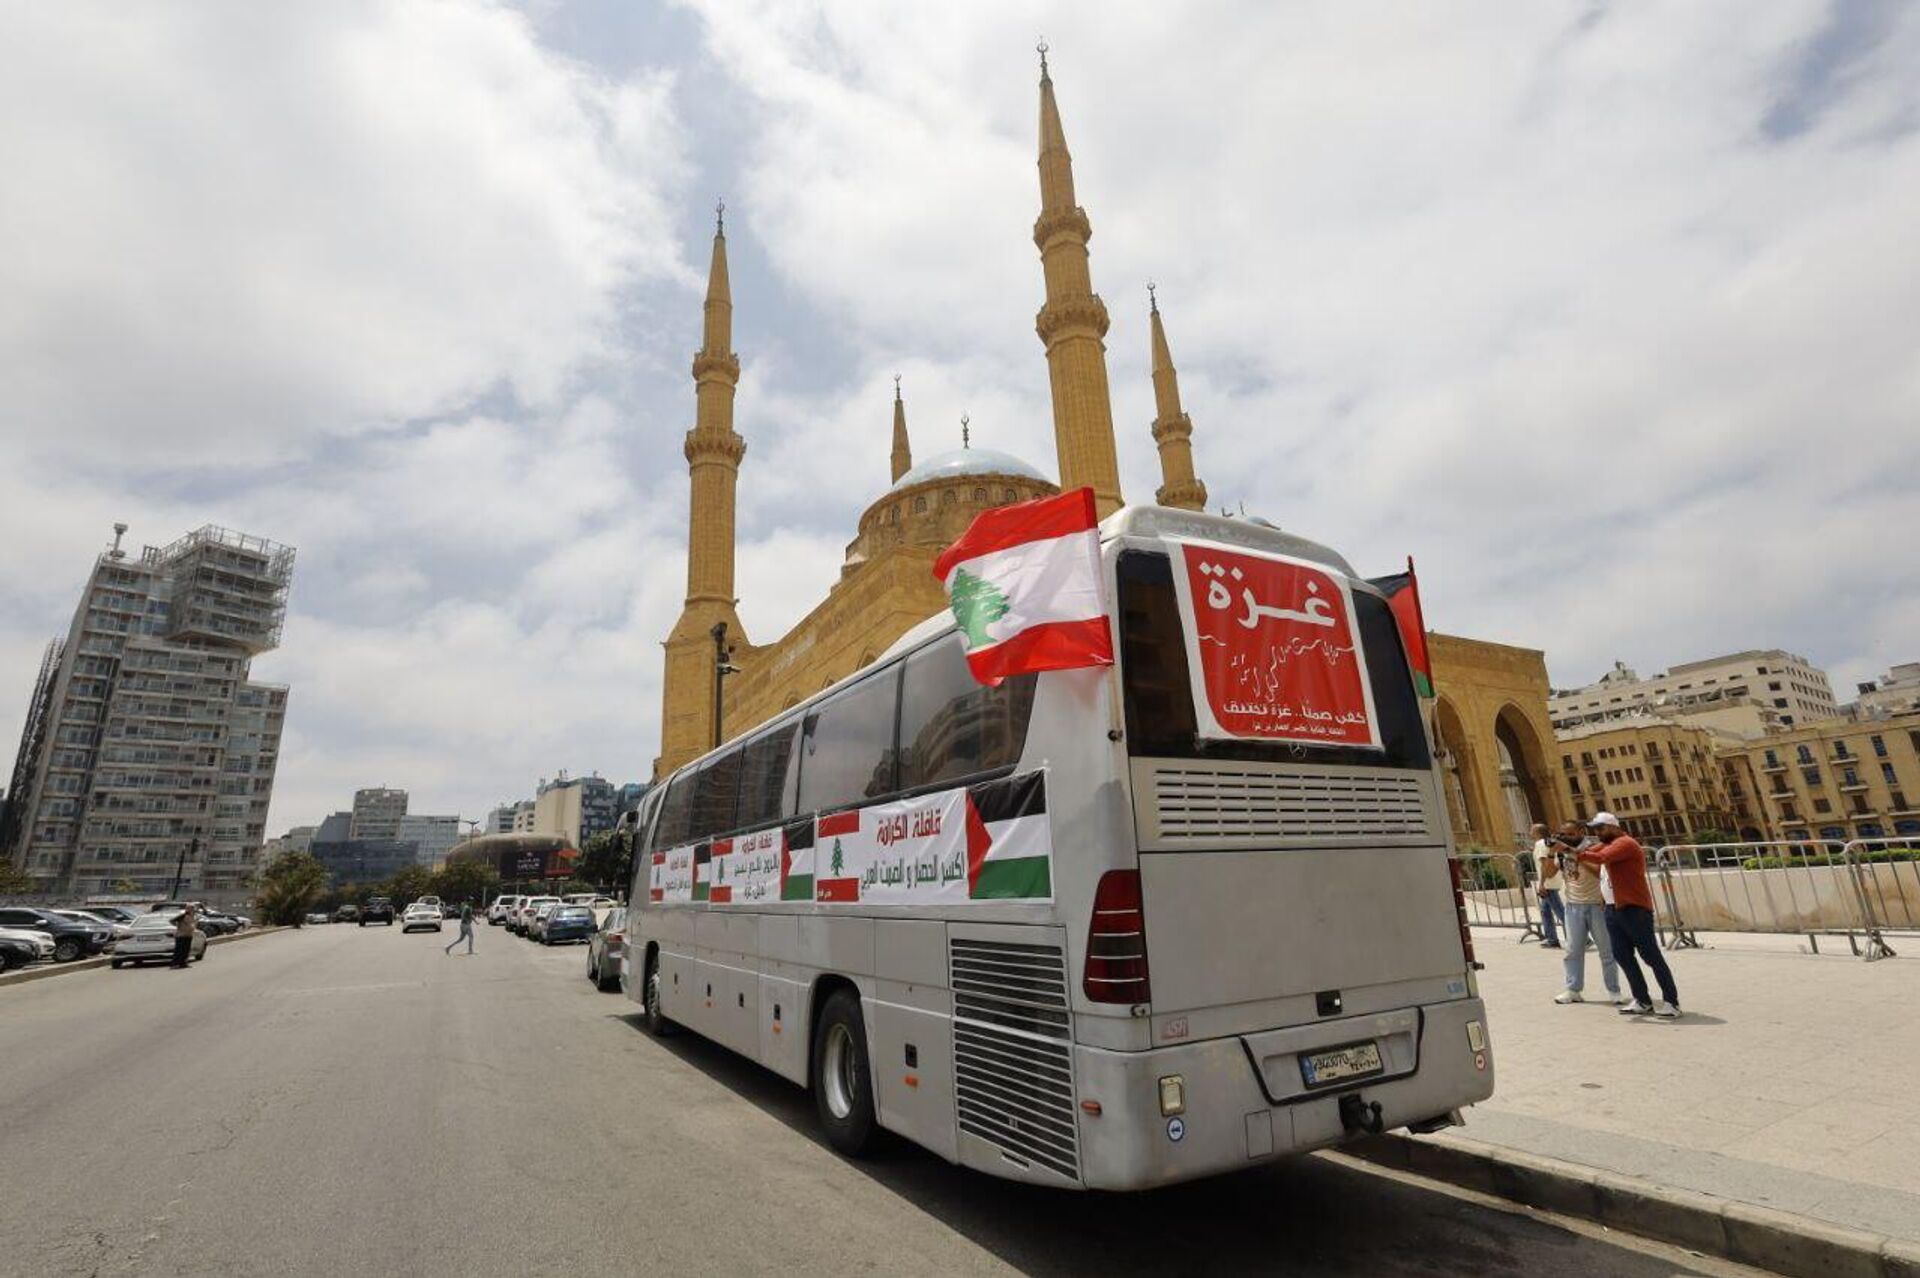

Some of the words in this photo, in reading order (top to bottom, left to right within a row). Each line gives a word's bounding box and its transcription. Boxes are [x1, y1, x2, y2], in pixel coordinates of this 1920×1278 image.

[1199, 561, 1336, 629] غزة
[1223, 700, 1268, 715] تختنق
[1271, 703, 1293, 719] غزة
[876, 814, 908, 847] الكرامة
[912, 808, 941, 838] قافلة
